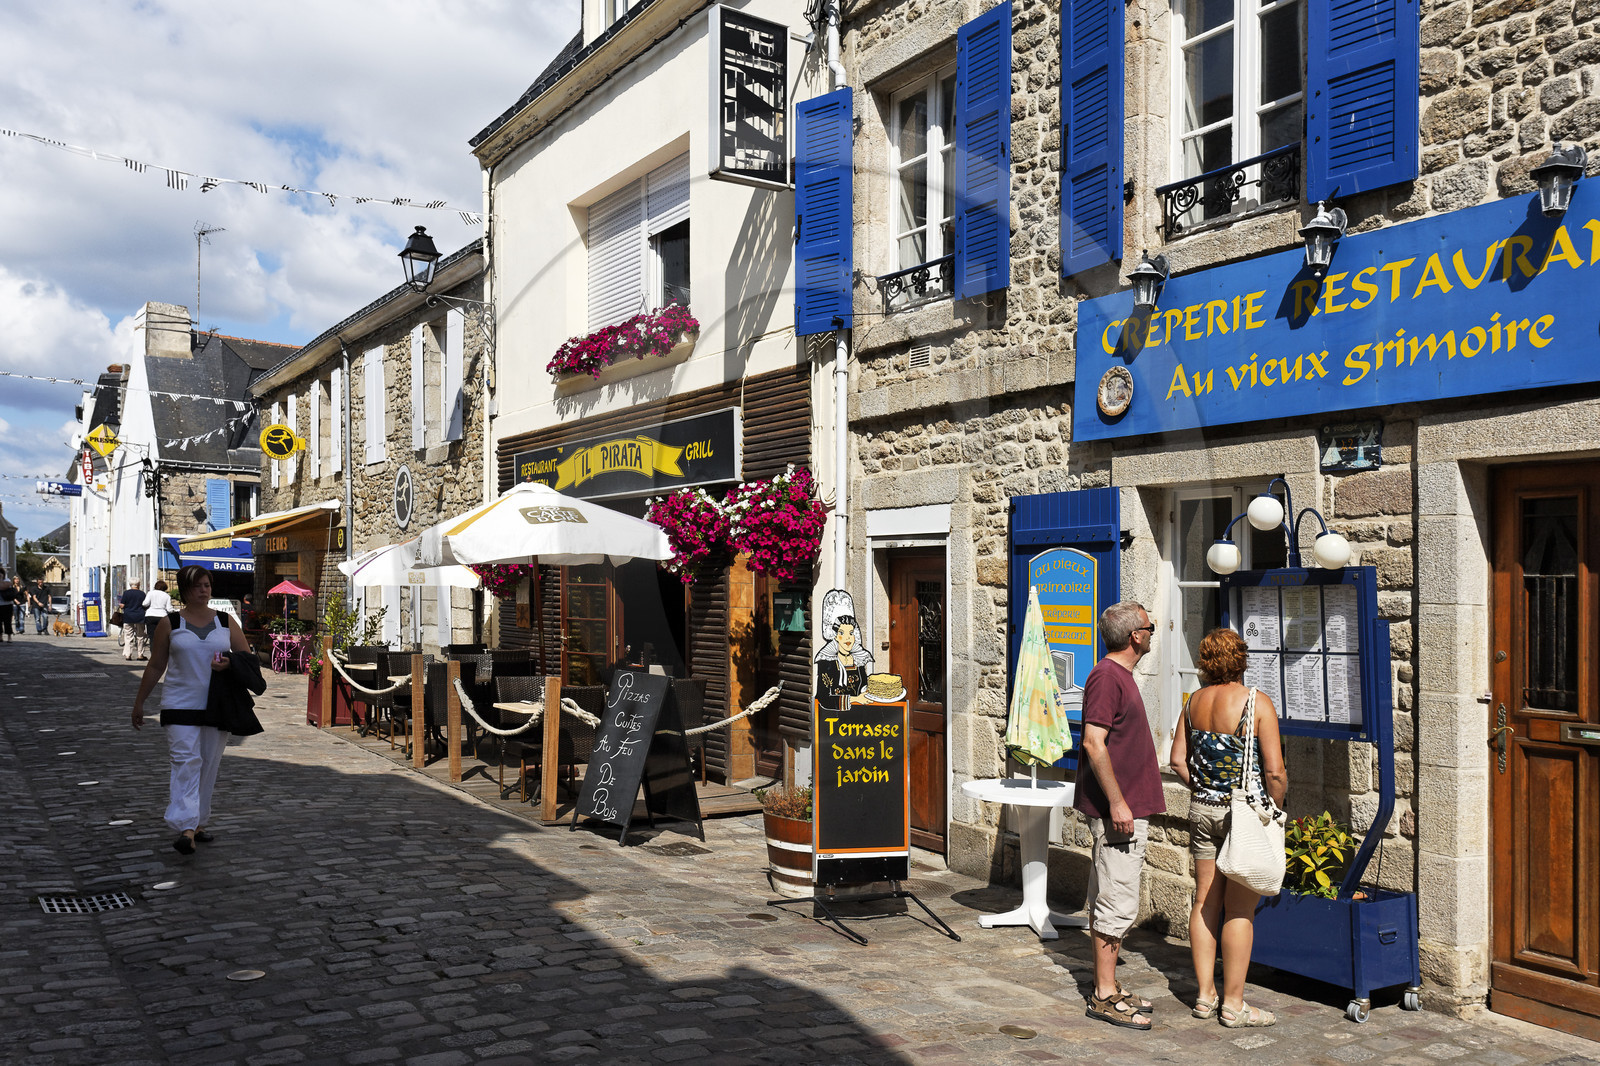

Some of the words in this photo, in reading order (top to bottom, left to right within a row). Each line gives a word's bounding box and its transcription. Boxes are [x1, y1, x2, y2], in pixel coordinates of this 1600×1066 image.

[1102, 290, 1266, 354] CRÊPERIE
[1166, 363, 1214, 401] Au
[1225, 350, 1330, 391] vieux
[1342, 311, 1555, 386] grimoire
[83, 449, 92, 483] TABAC
[521, 458, 557, 477] RESTAURANT
[581, 453, 592, 477] IL
[601, 443, 643, 469] PIRATA
[685, 439, 714, 461] GRILL
[266, 537, 288, 552] FLEURS
[213, 562, 233, 570] BAR
[1052, 558, 1089, 578] vieux
[1034, 582, 1091, 596] grimoire
[824, 717, 899, 738] Terrasse
[594, 734, 611, 753] Au
[832, 743, 875, 760] dans
[879, 740, 894, 760] le
[836, 764, 890, 788] jardin
